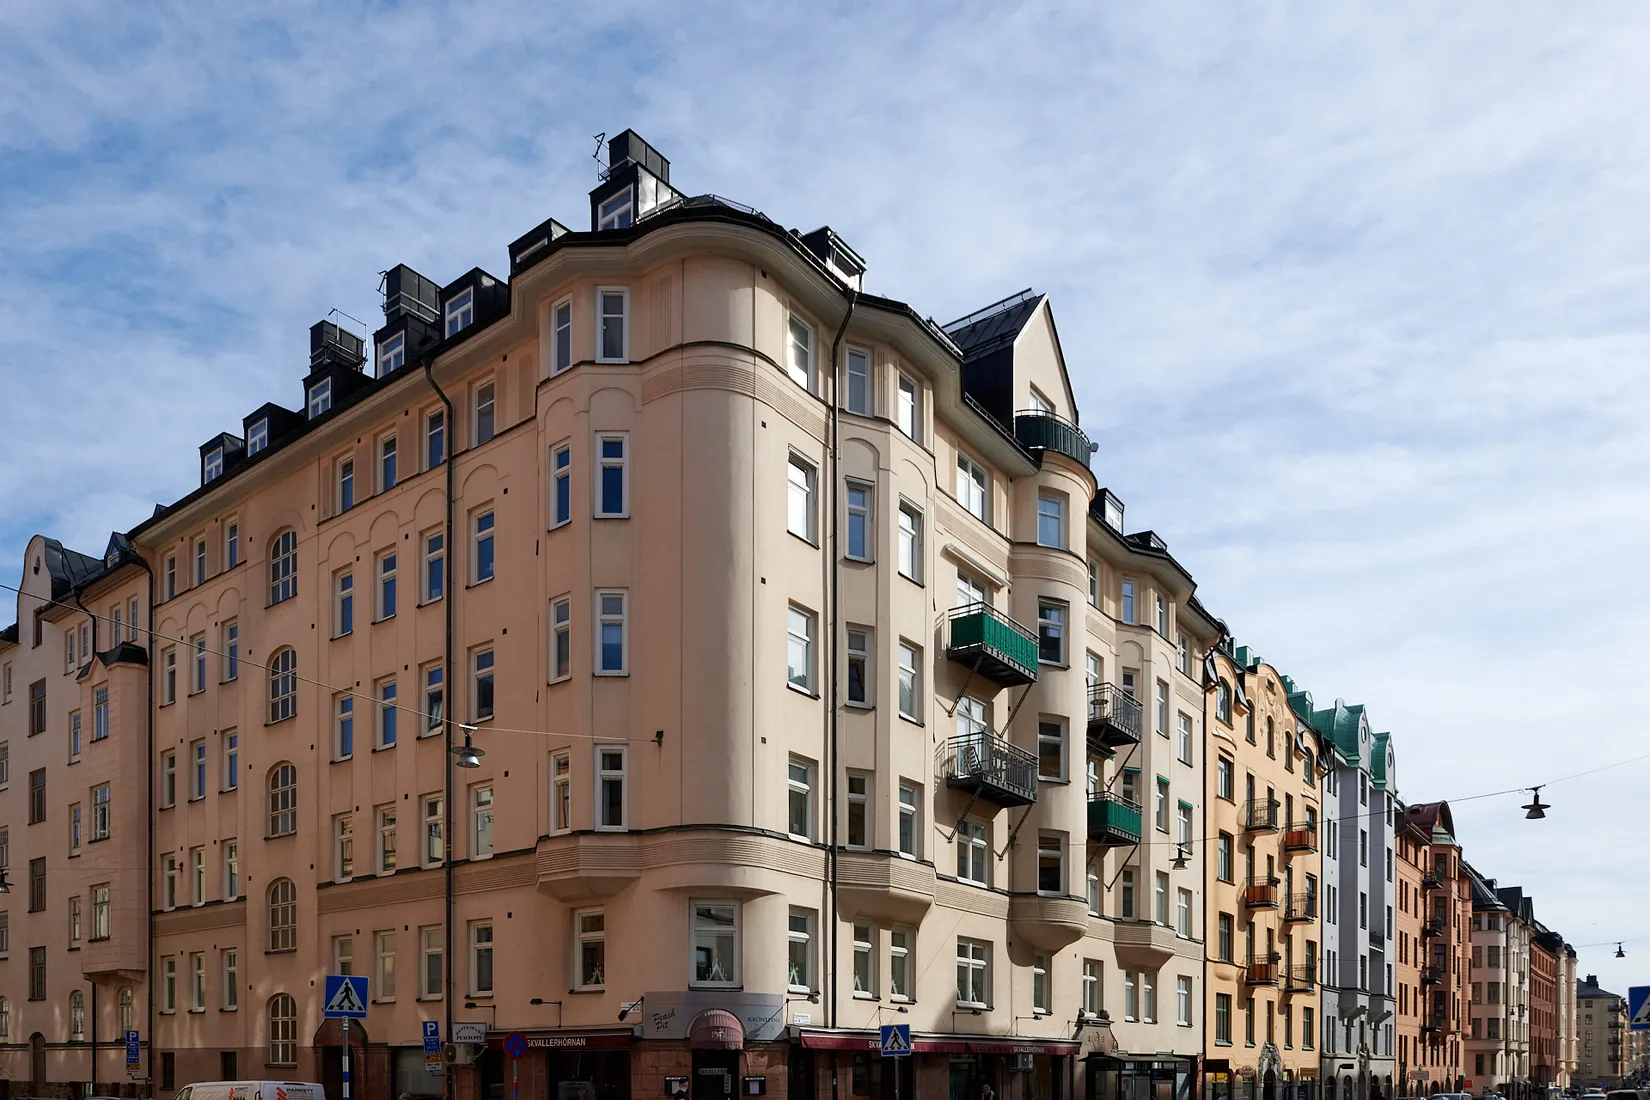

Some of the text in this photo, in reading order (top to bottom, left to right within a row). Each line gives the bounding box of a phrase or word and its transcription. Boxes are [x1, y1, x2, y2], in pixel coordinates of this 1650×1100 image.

[652, 1008, 676, 1023] Peach
[427, 1022, 437, 1037] P
[655, 1020, 669, 1032] Pit
[129, 1031, 138, 1042] P
[527, 1036, 587, 1048] SKVALLERHÖRNAN
